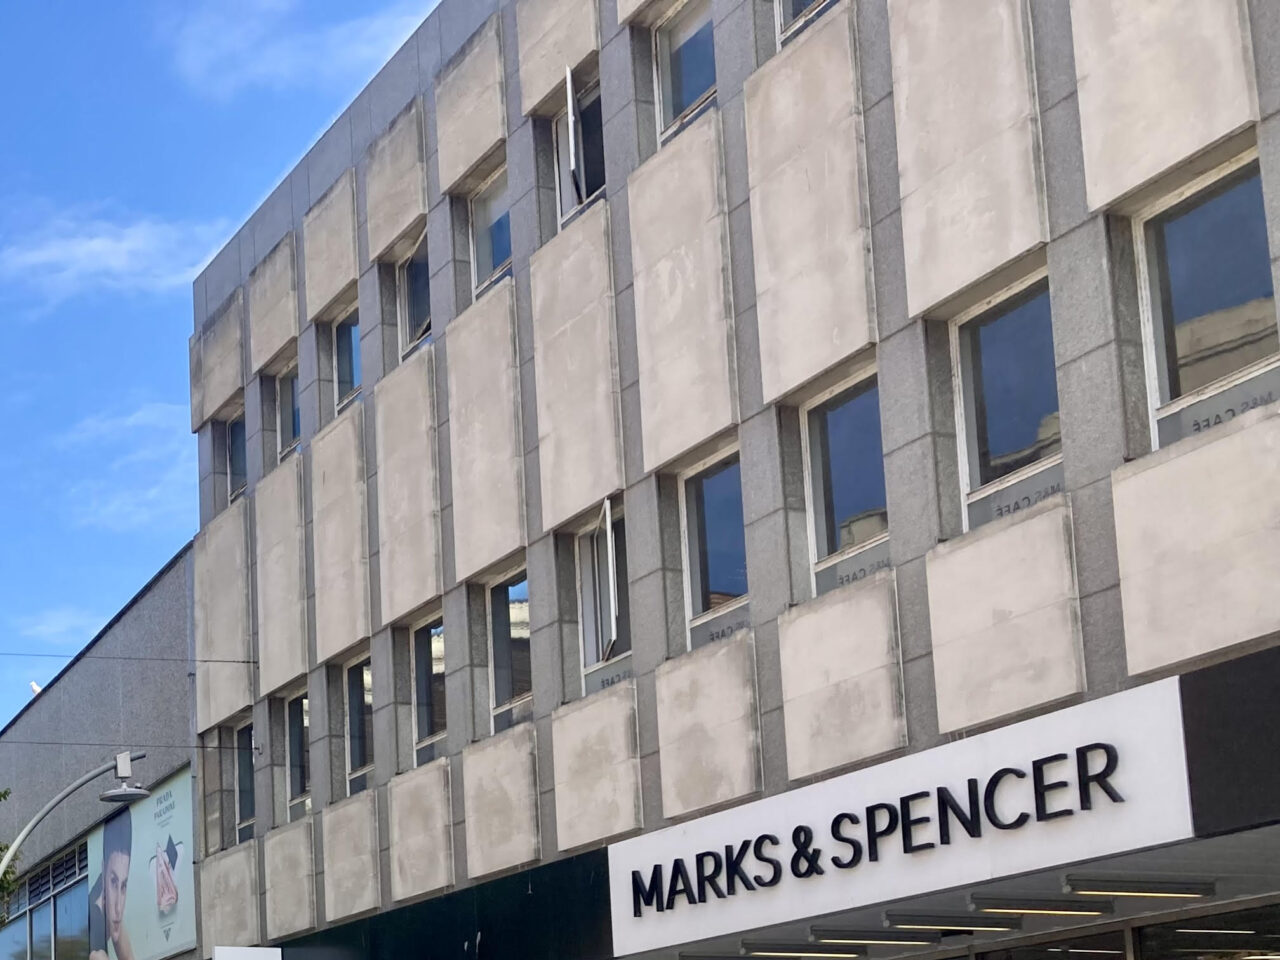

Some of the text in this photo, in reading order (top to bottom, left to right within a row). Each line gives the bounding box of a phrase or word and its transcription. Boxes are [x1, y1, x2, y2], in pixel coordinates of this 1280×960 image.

[631, 741, 1126, 918] MARKS & SPENCER
